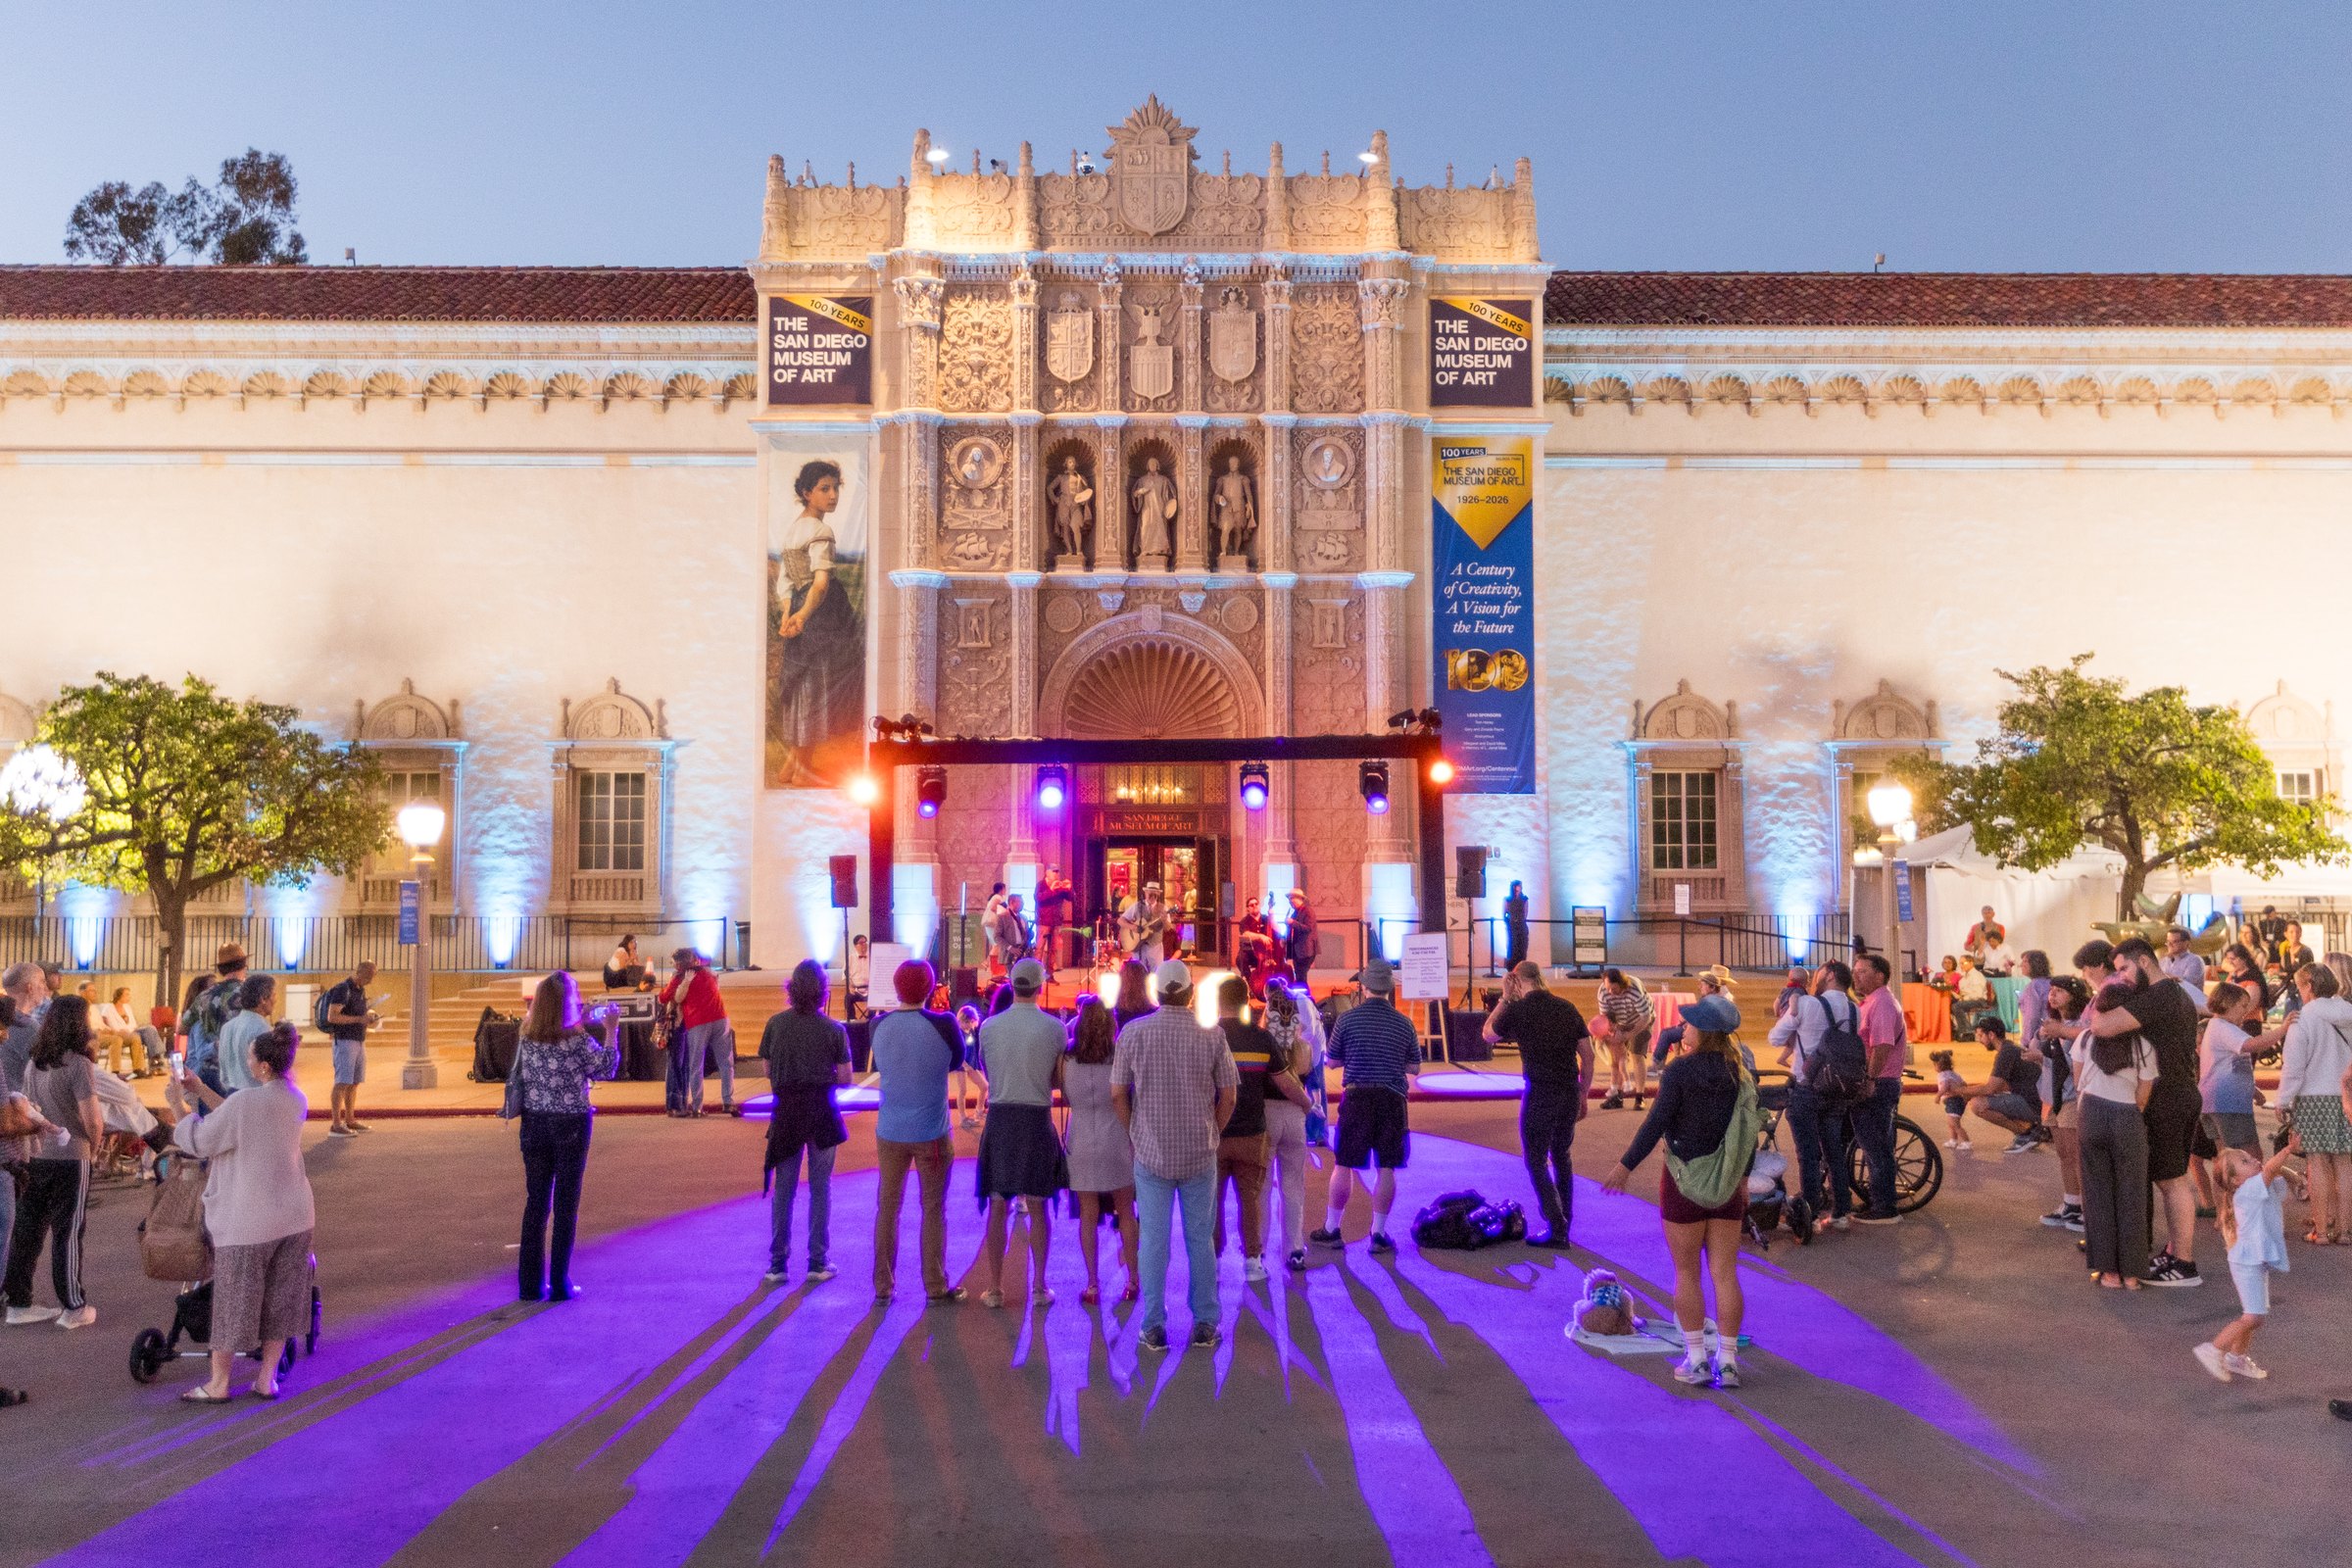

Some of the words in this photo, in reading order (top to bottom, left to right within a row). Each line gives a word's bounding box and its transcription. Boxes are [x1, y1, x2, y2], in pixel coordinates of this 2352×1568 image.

[809, 299, 829, 313] 100
[830, 308, 865, 328] YEARS
[1469, 302, 1488, 316] 100
[1489, 311, 1524, 332] YEARS
[774, 317, 808, 331] THE
[1435, 319, 1469, 333] THE
[774, 334, 809, 349] SAN
[813, 334, 867, 349] DIEGO
[1435, 337, 1470, 351] SAN
[1474, 337, 1528, 351] DIEGO
[774, 352, 852, 367] MUSEUM
[1436, 354, 1512, 368] MUSEUM
[774, 368, 798, 383] OF
[801, 368, 836, 383] ART
[1435, 371, 1459, 385] OF
[1462, 371, 1496, 385] ART
[1442, 448, 1460, 458] 100
[1446, 467, 1463, 476] THE
[1465, 467, 1485, 476] SAN
[1487, 467, 1516, 476] DIEGO
[1444, 476, 1486, 486] MUSEUM
[1487, 476, 1499, 486] OF
[1500, 476, 1519, 486] ART
[1450, 563, 1463, 576] A
[1466, 562, 1516, 579] Century
[1444, 581, 1459, 599] of
[1458, 581, 1522, 599] Creativity,
[1446, 601, 1459, 614] A
[1463, 601, 1500, 614] Vision
[1499, 601, 1522, 618] for
[1452, 620, 1472, 634] the
[1473, 620, 1515, 634] Future
